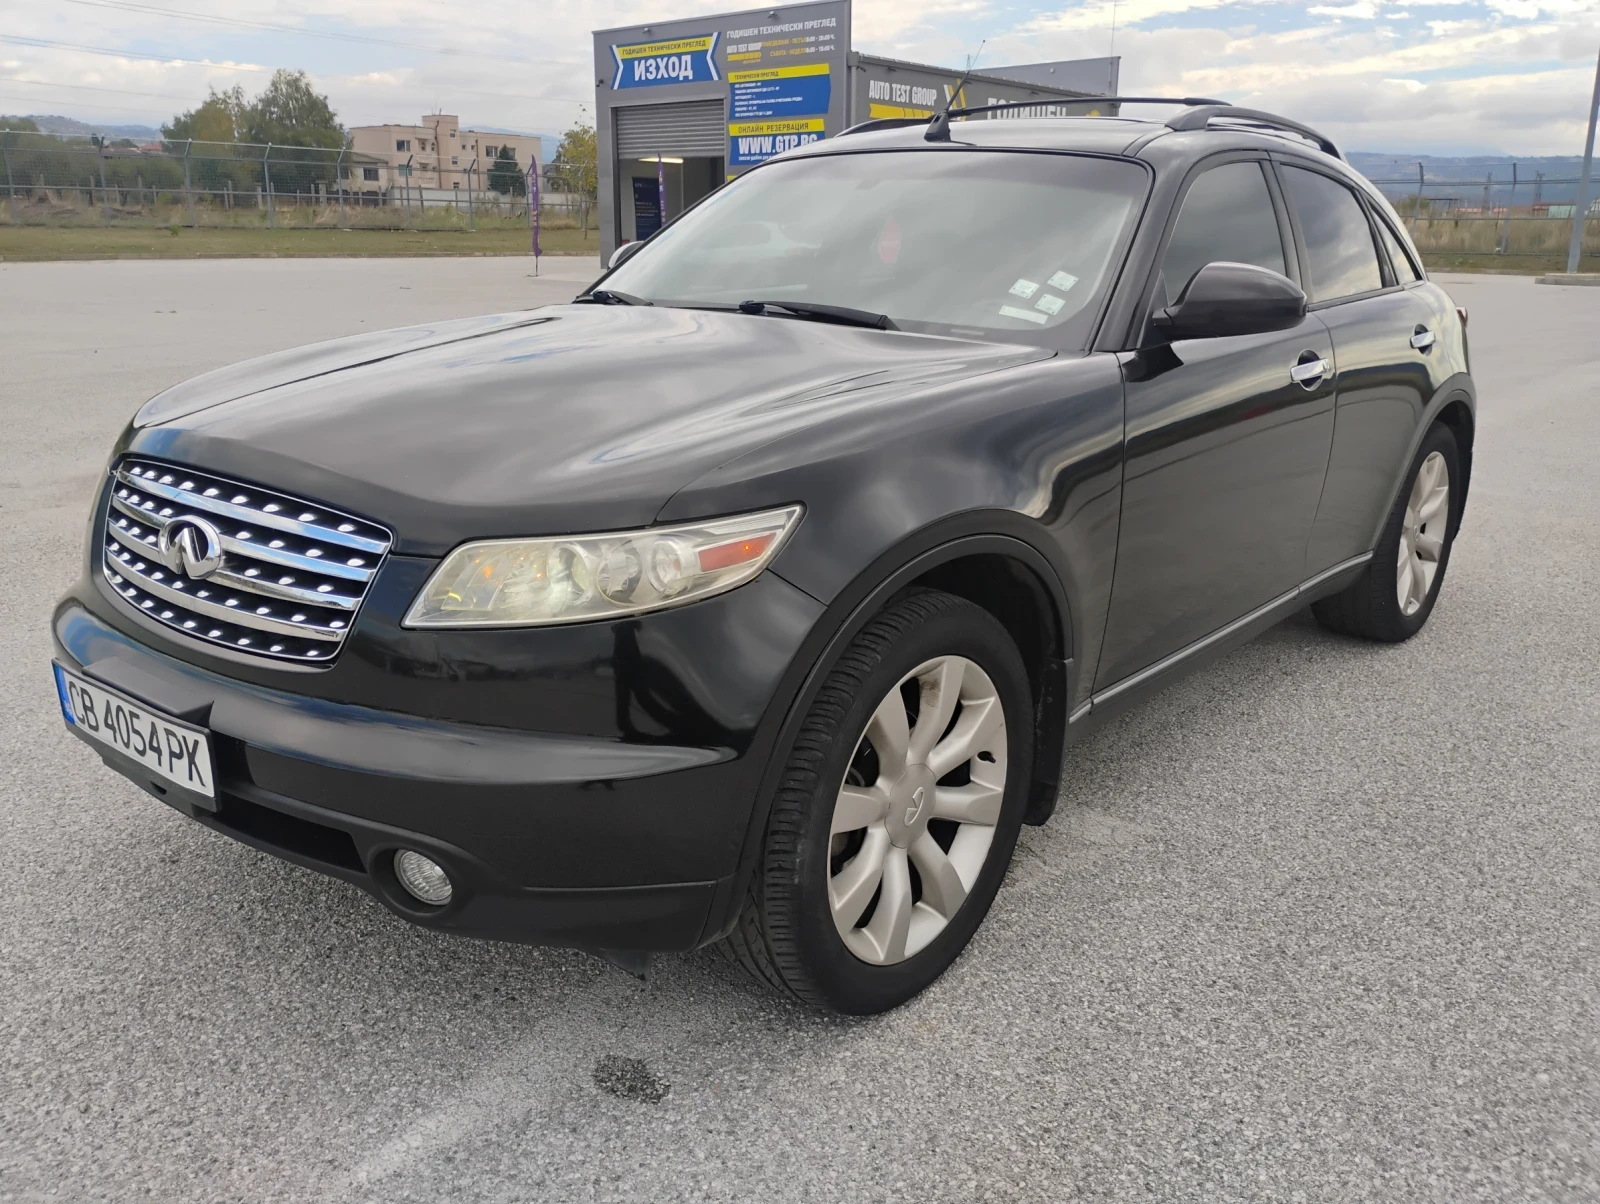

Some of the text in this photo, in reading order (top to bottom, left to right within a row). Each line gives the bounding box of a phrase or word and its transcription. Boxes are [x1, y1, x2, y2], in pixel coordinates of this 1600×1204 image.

[727, 18, 836, 39] ГОДИШЕН ТЕХНИЧЕСКИ ПРЕГЛЕД
[622, 40, 706, 55] ГОДИШЕН ТЕХНИЧЕСКИ ПРЕГЛЕД
[634, 55, 693, 81] ИЗХОД
[869, 80, 937, 106] AUTO TEST GROUP
[766, 123, 809, 132] РЕЗЕРВАЦИЯ
[738, 134, 817, 154] WWW.GTPBG
[69, 681, 206, 787] CB 4054 PK
